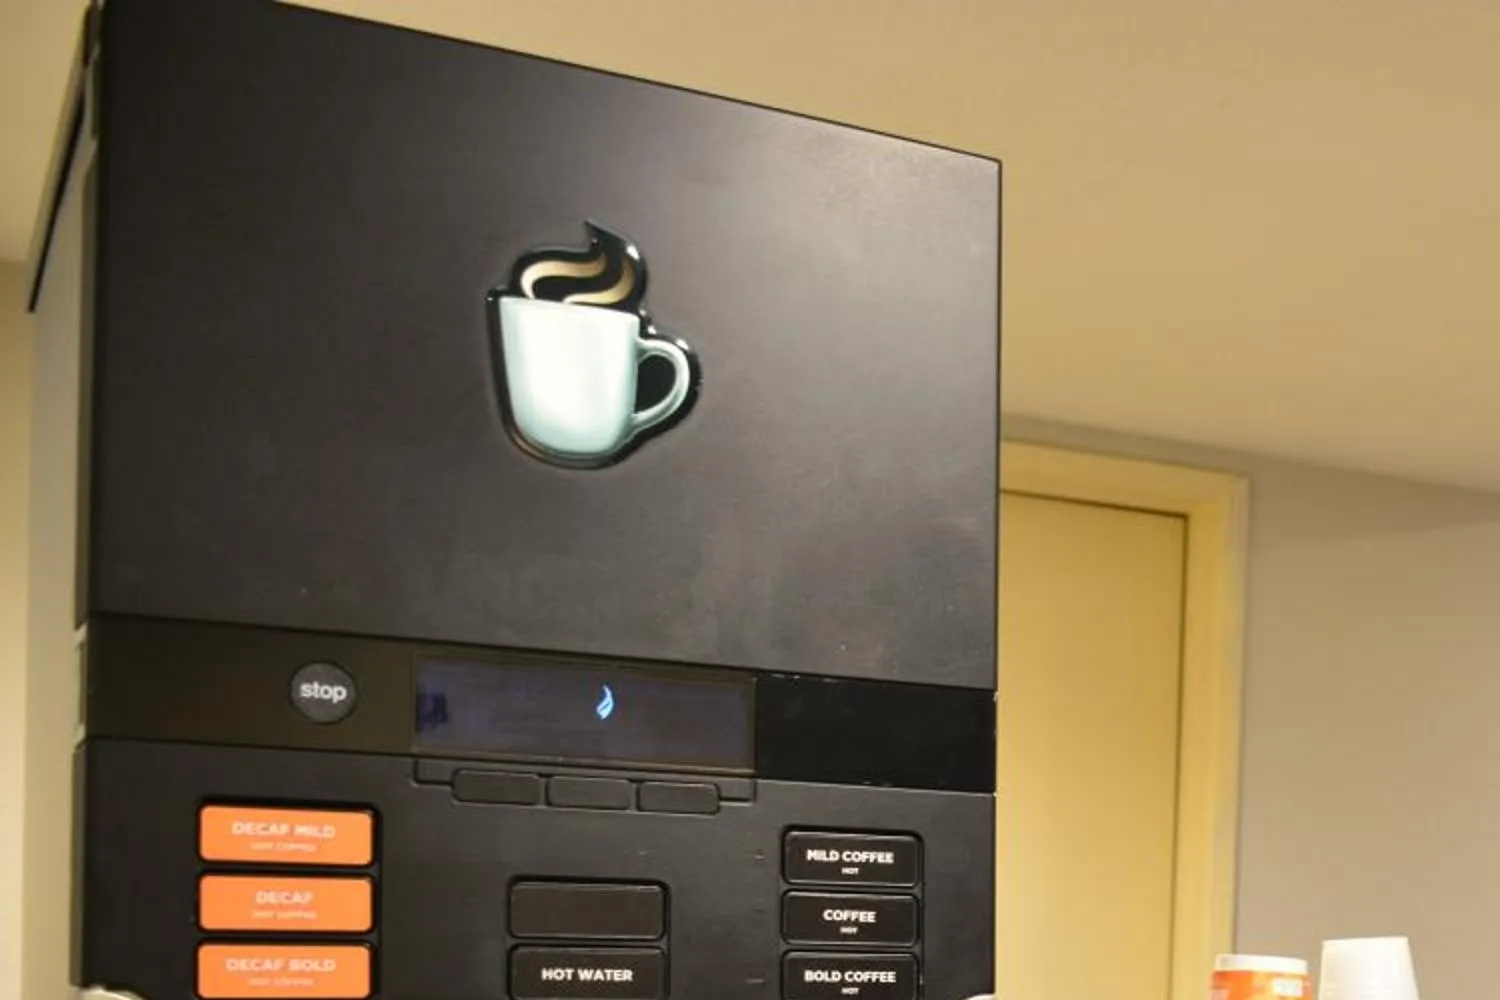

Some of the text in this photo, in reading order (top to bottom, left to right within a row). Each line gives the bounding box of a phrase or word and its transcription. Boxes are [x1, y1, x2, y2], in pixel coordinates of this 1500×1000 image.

[300, 681, 348, 704] stop
[231, 821, 336, 839] DECAF MILD
[806, 849, 895, 864] MILD COFFEE
[255, 890, 314, 905] DECAF
[822, 909, 877, 923] COFFEE
[225, 958, 336, 973] DECAF BOLD
[541, 967, 634, 982] HOT WATER
[804, 969, 897, 983] BOLD COFFEE
